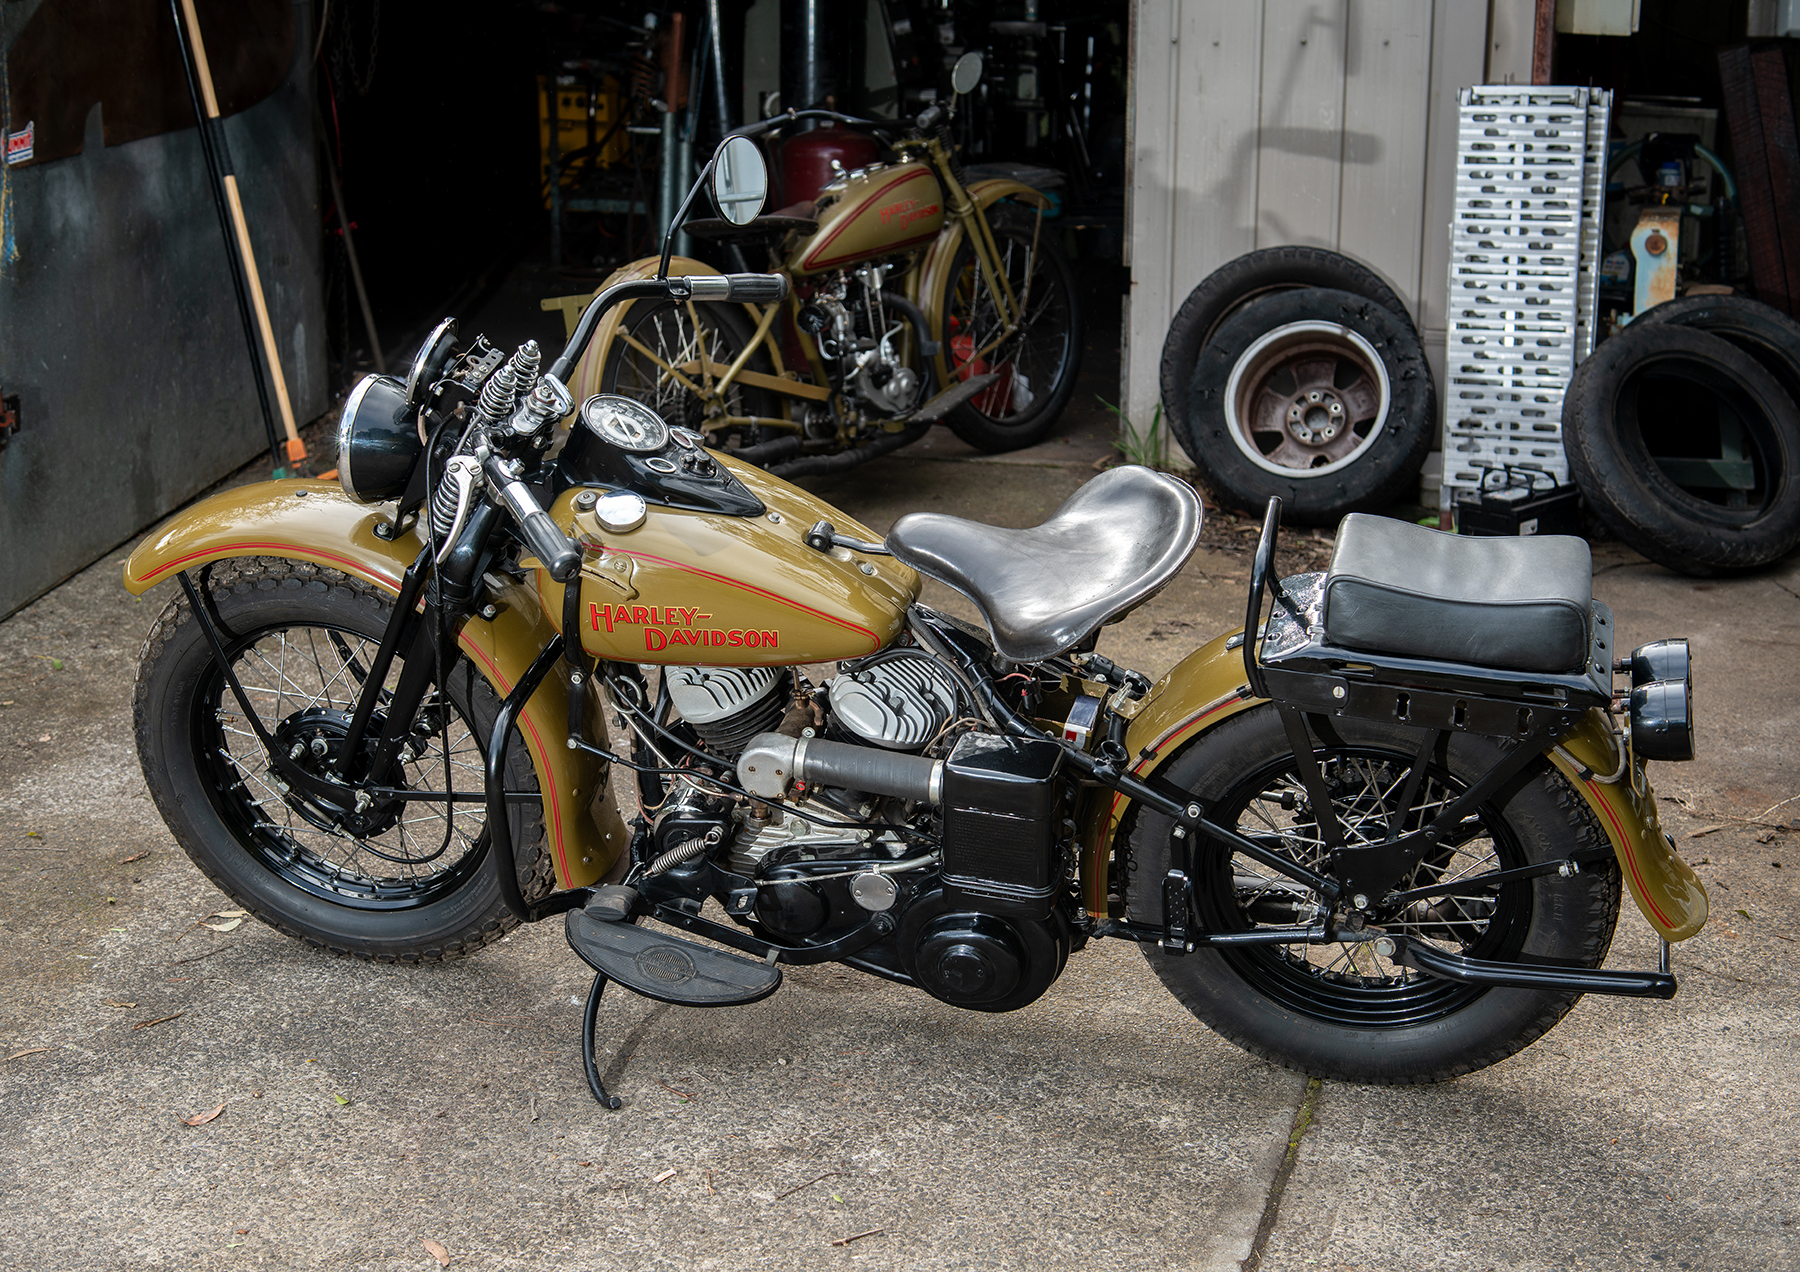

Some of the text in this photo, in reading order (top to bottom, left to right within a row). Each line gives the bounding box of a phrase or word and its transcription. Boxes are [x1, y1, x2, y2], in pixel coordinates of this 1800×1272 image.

[900, 203, 939, 230] DAVIDSON
[589, 602, 713, 633] HARLEY-
[643, 626, 779, 651] DAVIDSON
